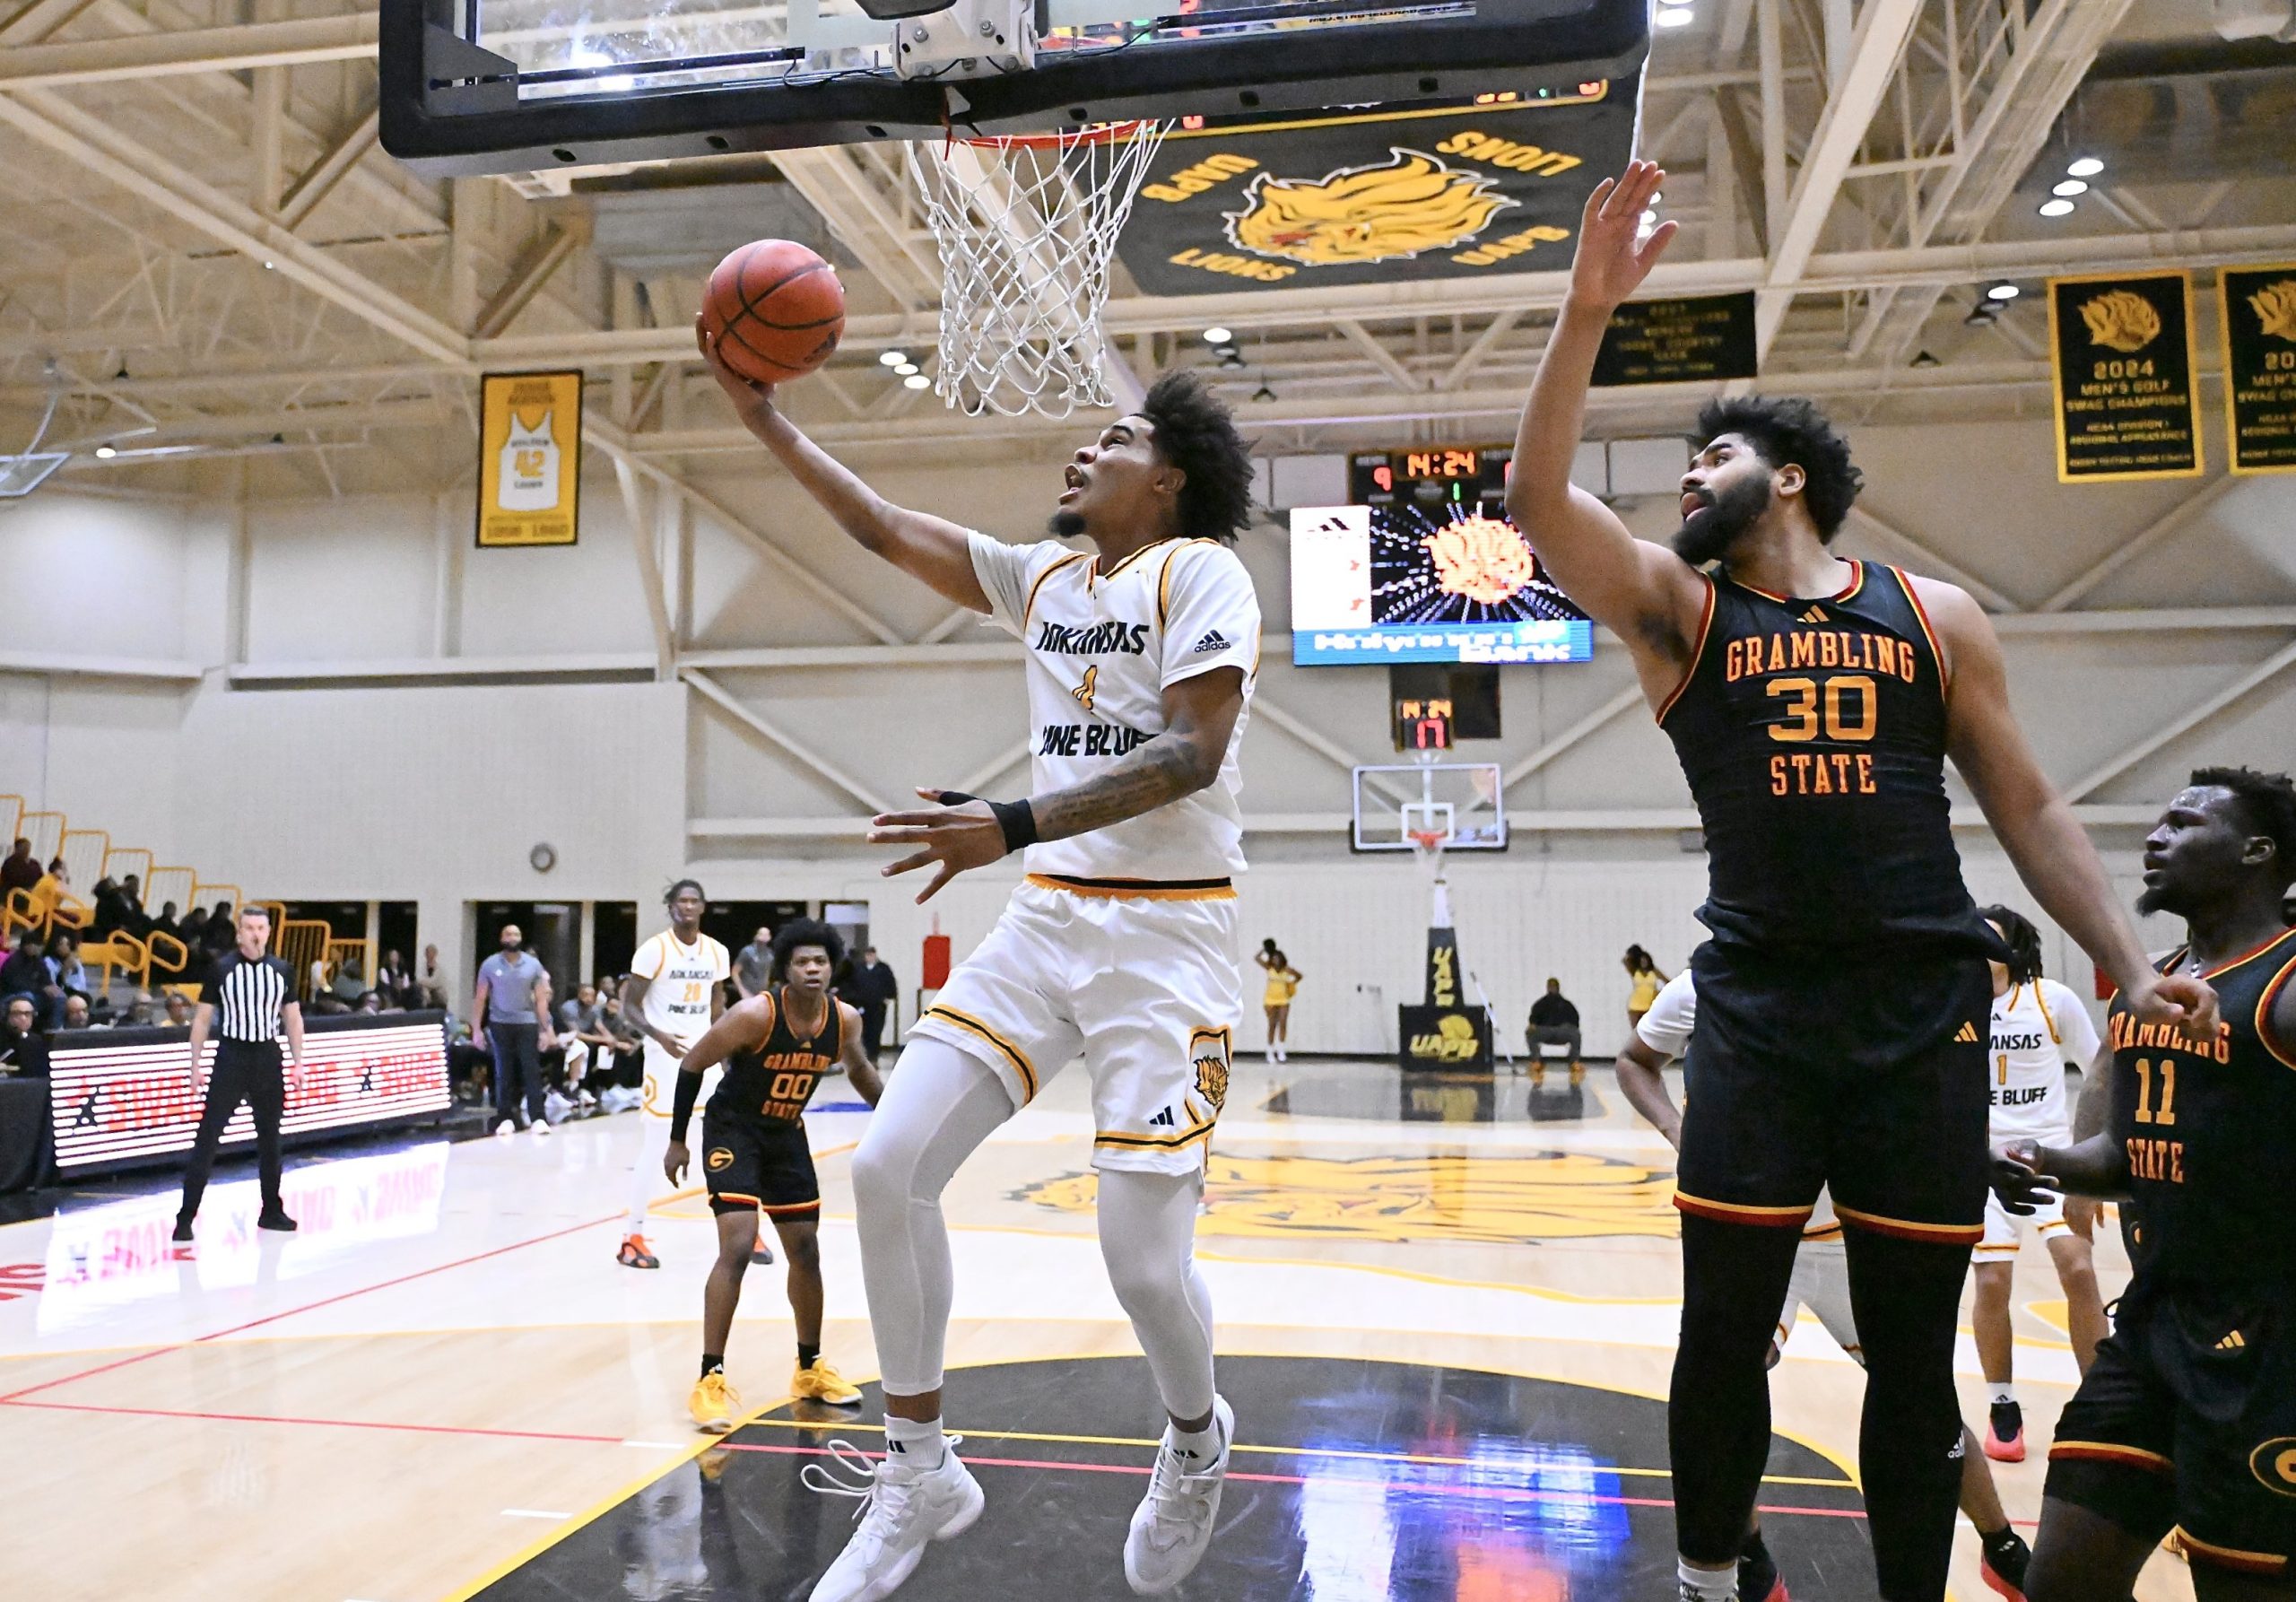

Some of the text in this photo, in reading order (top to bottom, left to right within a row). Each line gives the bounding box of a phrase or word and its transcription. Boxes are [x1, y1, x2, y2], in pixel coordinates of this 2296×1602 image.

[1436, 131, 1583, 177] LIONS
[1141, 153, 1260, 203] UAPB
[1170, 248, 1297, 282] LIONS
[2265, 353, 2296, 370] 20
[1373, 466, 1392, 492] 9
[1194, 640, 1231, 653] adidas
[1726, 631, 1916, 683] GRAMBLING
[1766, 675, 1877, 742] 30
[1084, 725, 1160, 756] BLUF
[1770, 753, 1877, 796] STATE
[1990, 1033, 2042, 1050] ANSAS
[1997, 1054, 2007, 1085] 1
[770, 1074, 813, 1100] 00
[2003, 1086, 2047, 1106] BLUFF
[2135, 1058, 2176, 1126] 11
[2126, 1137, 2184, 1184] STATE
